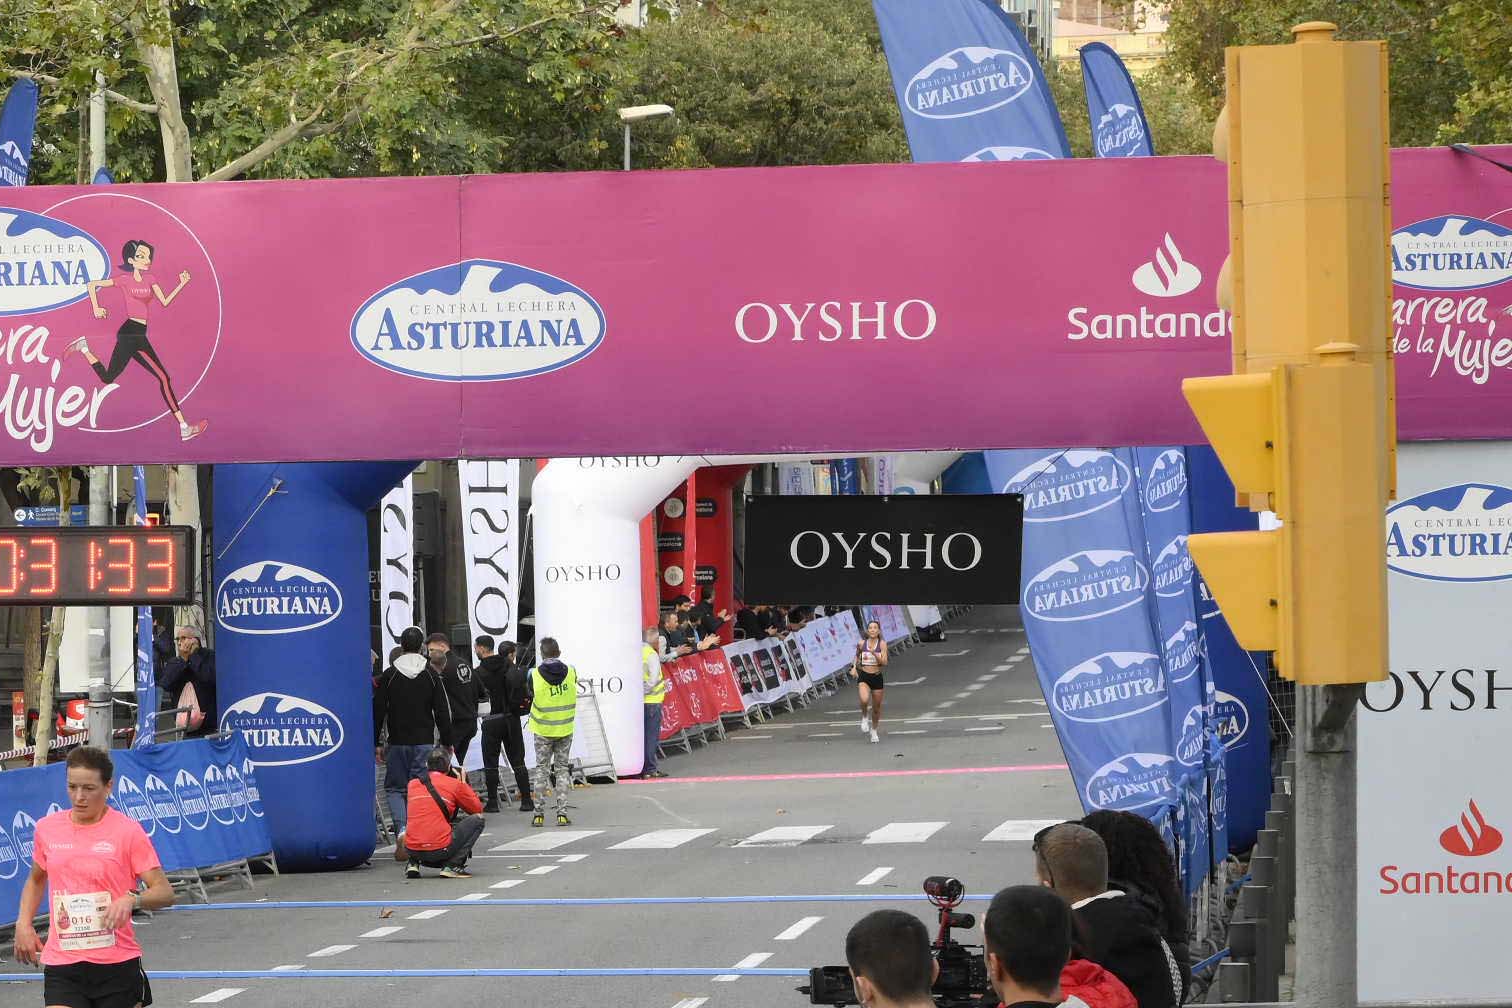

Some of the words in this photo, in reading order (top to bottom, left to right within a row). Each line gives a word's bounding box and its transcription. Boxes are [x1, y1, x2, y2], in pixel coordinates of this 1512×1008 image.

[12, 242, 86, 255] LECHERA
[410, 302, 488, 315] CENTRAL
[496, 300, 578, 313] LECHERA
[1392, 296, 1488, 326] arrera
[370, 306, 586, 353] ASTURIANA
[734, 299, 938, 344] OYSHO
[1067, 306, 1232, 340] Santand
[1416, 326, 1434, 354] la
[1430, 319, 1512, 385] Muje
[1414, 518, 1481, 528] CENTRAL
[790, 530, 983, 571] OYSHO
[545, 563, 621, 584] OYSHO
[232, 586, 276, 594] CENTRAL
[279, 585, 328, 593] LECHERA
[220, 591, 333, 618] ASTURIANA
[549, 683, 568, 697] Life
[577, 676, 623, 695] SHO
[1361, 668, 1512, 712] OYSH
[280, 717, 329, 726] LECHERA
